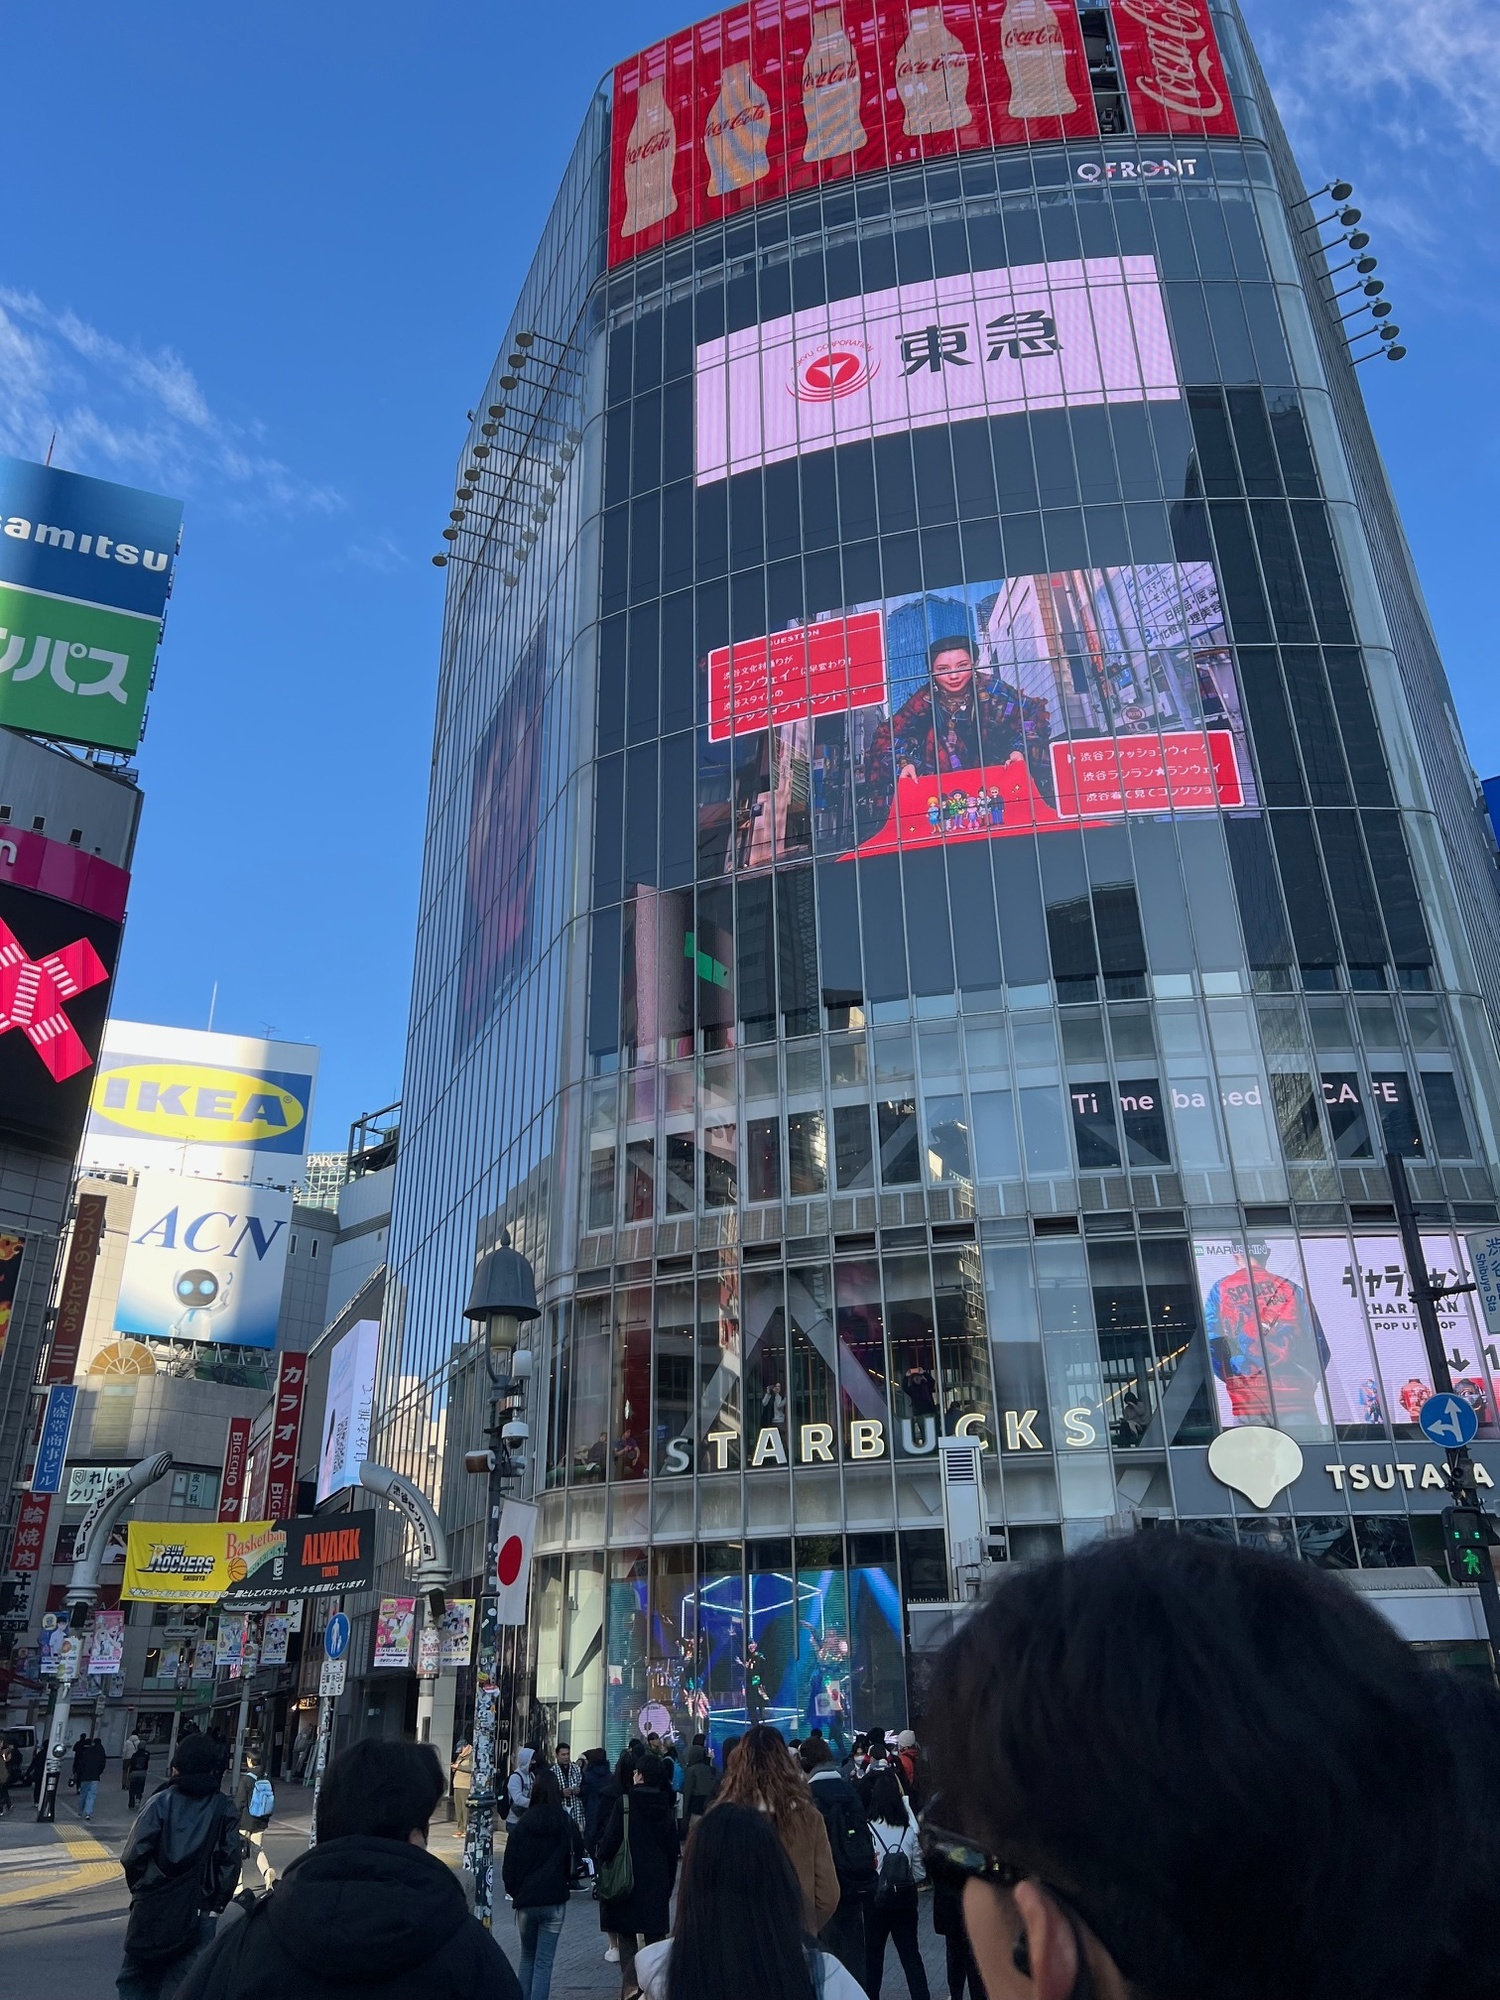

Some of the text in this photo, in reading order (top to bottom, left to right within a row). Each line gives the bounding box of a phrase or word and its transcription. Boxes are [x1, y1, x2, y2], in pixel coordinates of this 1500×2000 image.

[1077, 159, 1197, 182] QFRONT
[895, 309, 1064, 378] 東急
[0, 515, 170, 572] amitsu
[102, 1076, 288, 1127] IKEA
[1321, 1082, 1399, 1104] CAFE
[131, 1205, 288, 1262] ACN
[62, 1202, 100, 1333] クスリのことなら
[1475, 1253, 1492, 1292] Shibuya
[1484, 1291, 1497, 1315] Sta.
[1374, 1321, 1398, 1331] POP
[272, 1366, 303, 1469] カラオケ
[665, 1407, 1096, 1473] STARBUCKS
[75, 1477, 126, 1558] 渋谷センター街
[226, 1529, 286, 1560] Basketball
[393, 1484, 432, 1557] 渋谷センター街
[148, 1543, 215, 1575] ROCKERS
[165, 1544, 184, 1556] SUN
[301, 1527, 360, 1566] ALVARK
[321, 1565, 339, 1578] TOKYO
